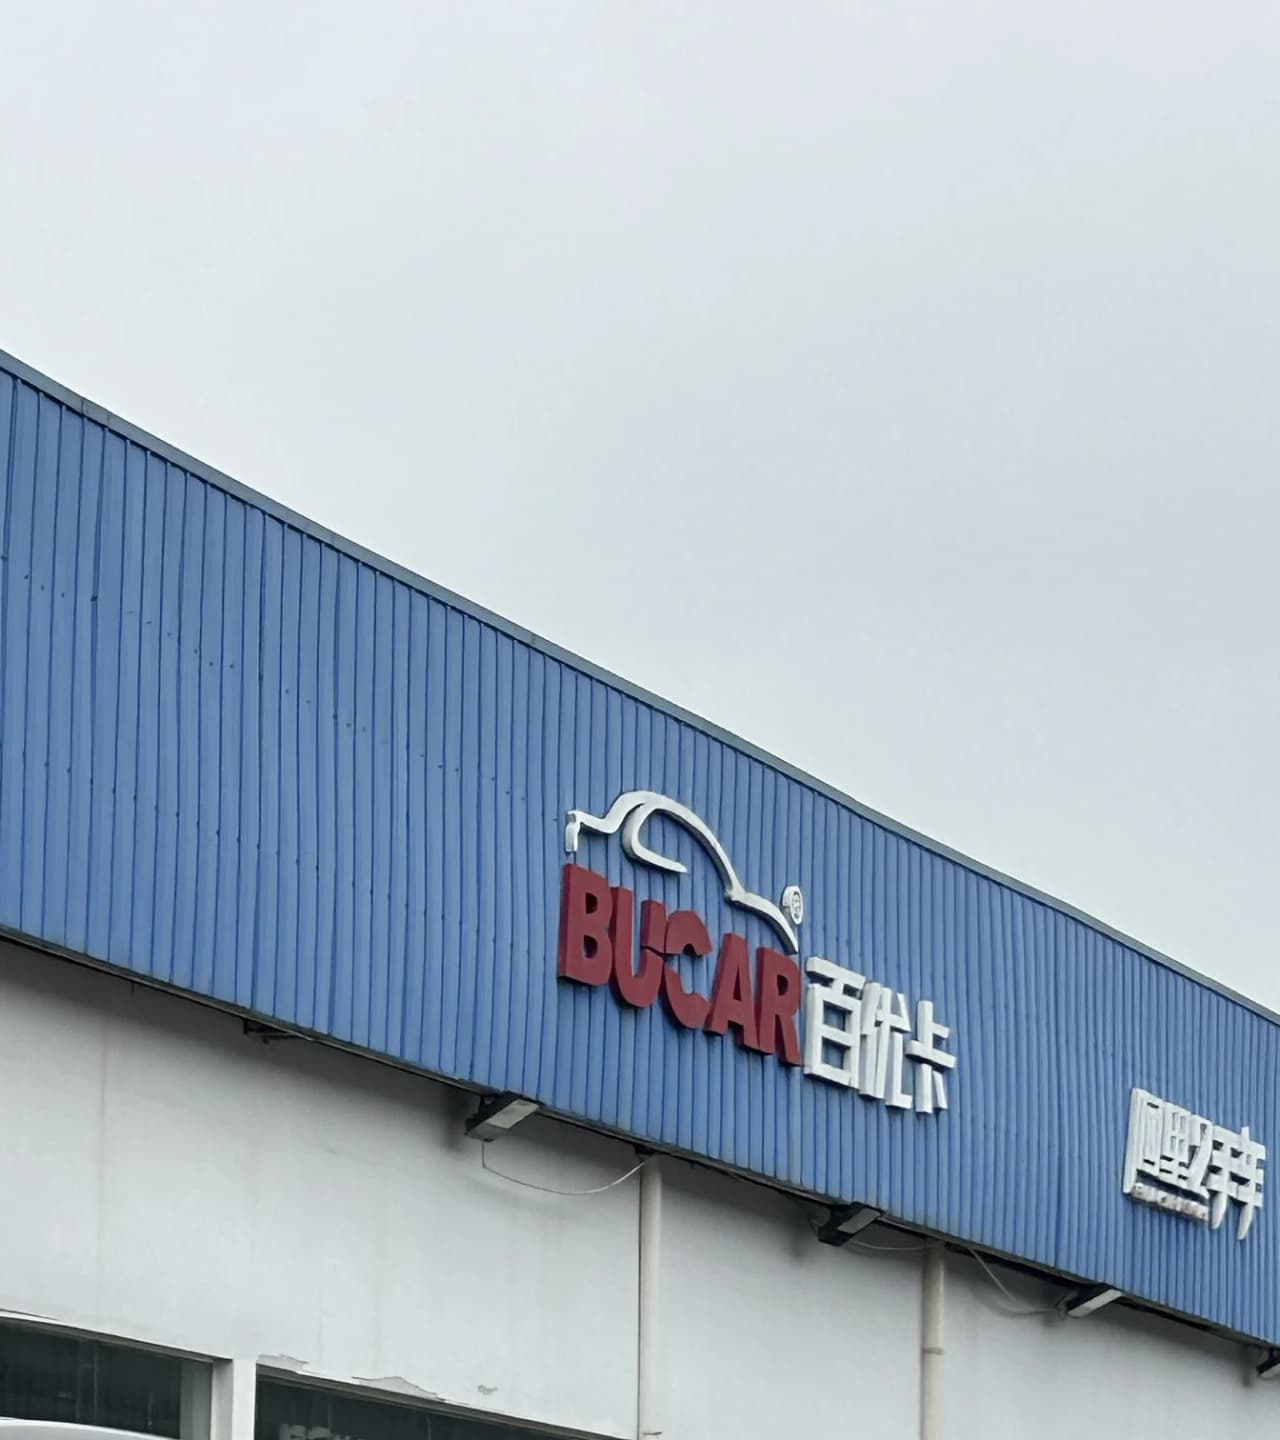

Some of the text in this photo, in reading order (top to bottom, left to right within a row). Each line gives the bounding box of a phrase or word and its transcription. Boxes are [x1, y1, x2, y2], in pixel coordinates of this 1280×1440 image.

[557, 862, 957, 1115] BUCAR 百优卡
